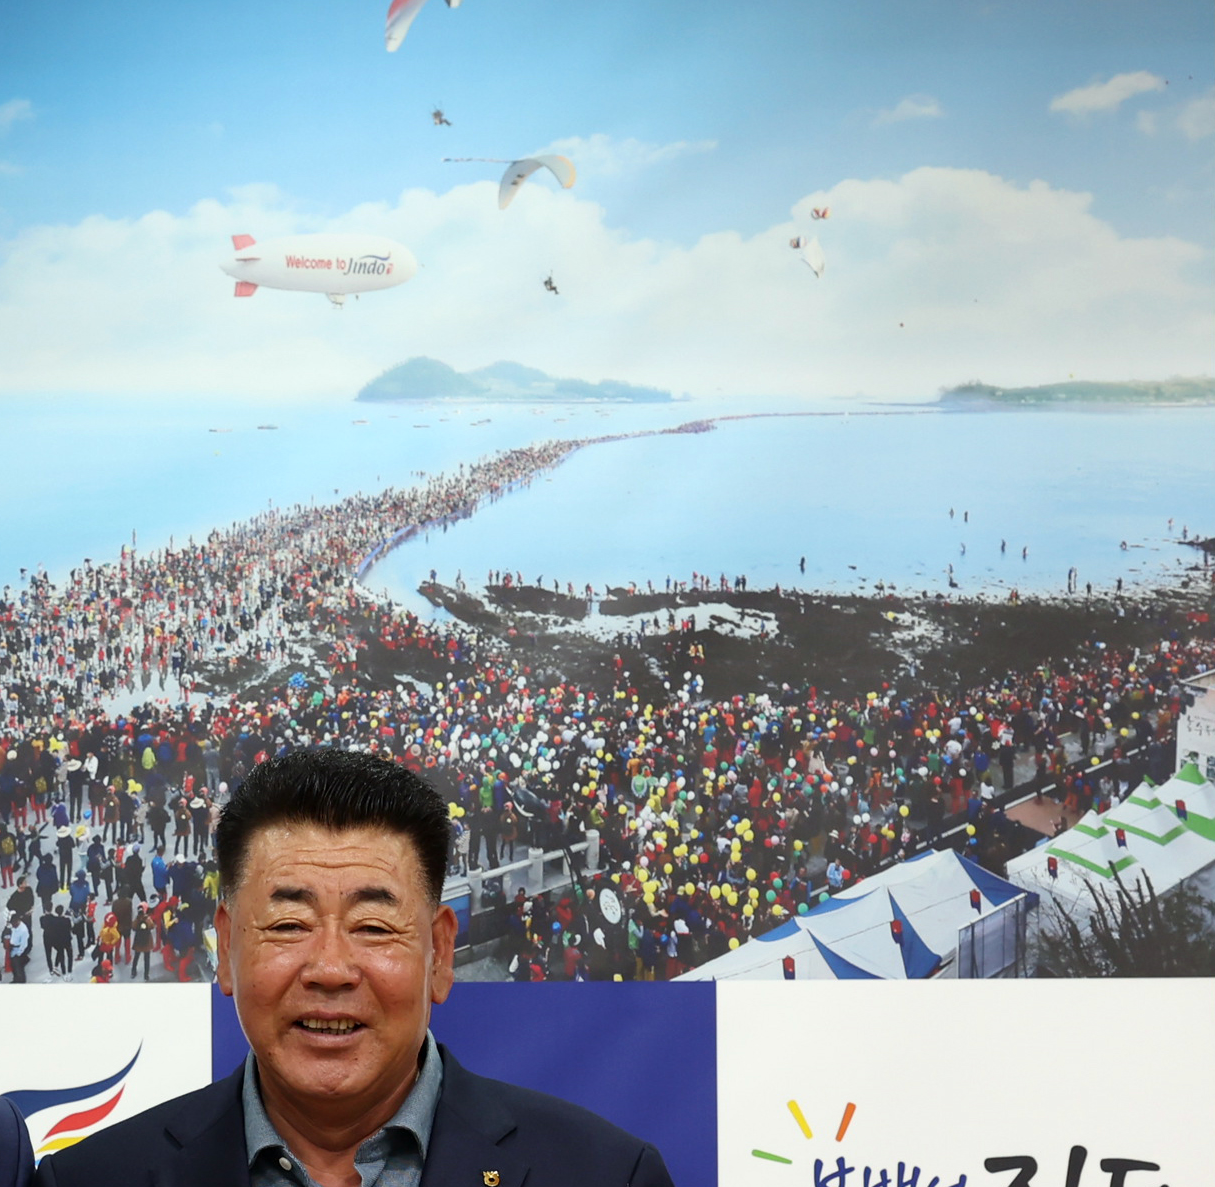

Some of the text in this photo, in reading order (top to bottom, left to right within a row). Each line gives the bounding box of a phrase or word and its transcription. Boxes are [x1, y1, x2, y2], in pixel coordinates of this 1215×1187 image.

[285, 255, 332, 270] Welcome
[336, 257, 346, 270] to
[343, 257, 386, 275] Jindo
